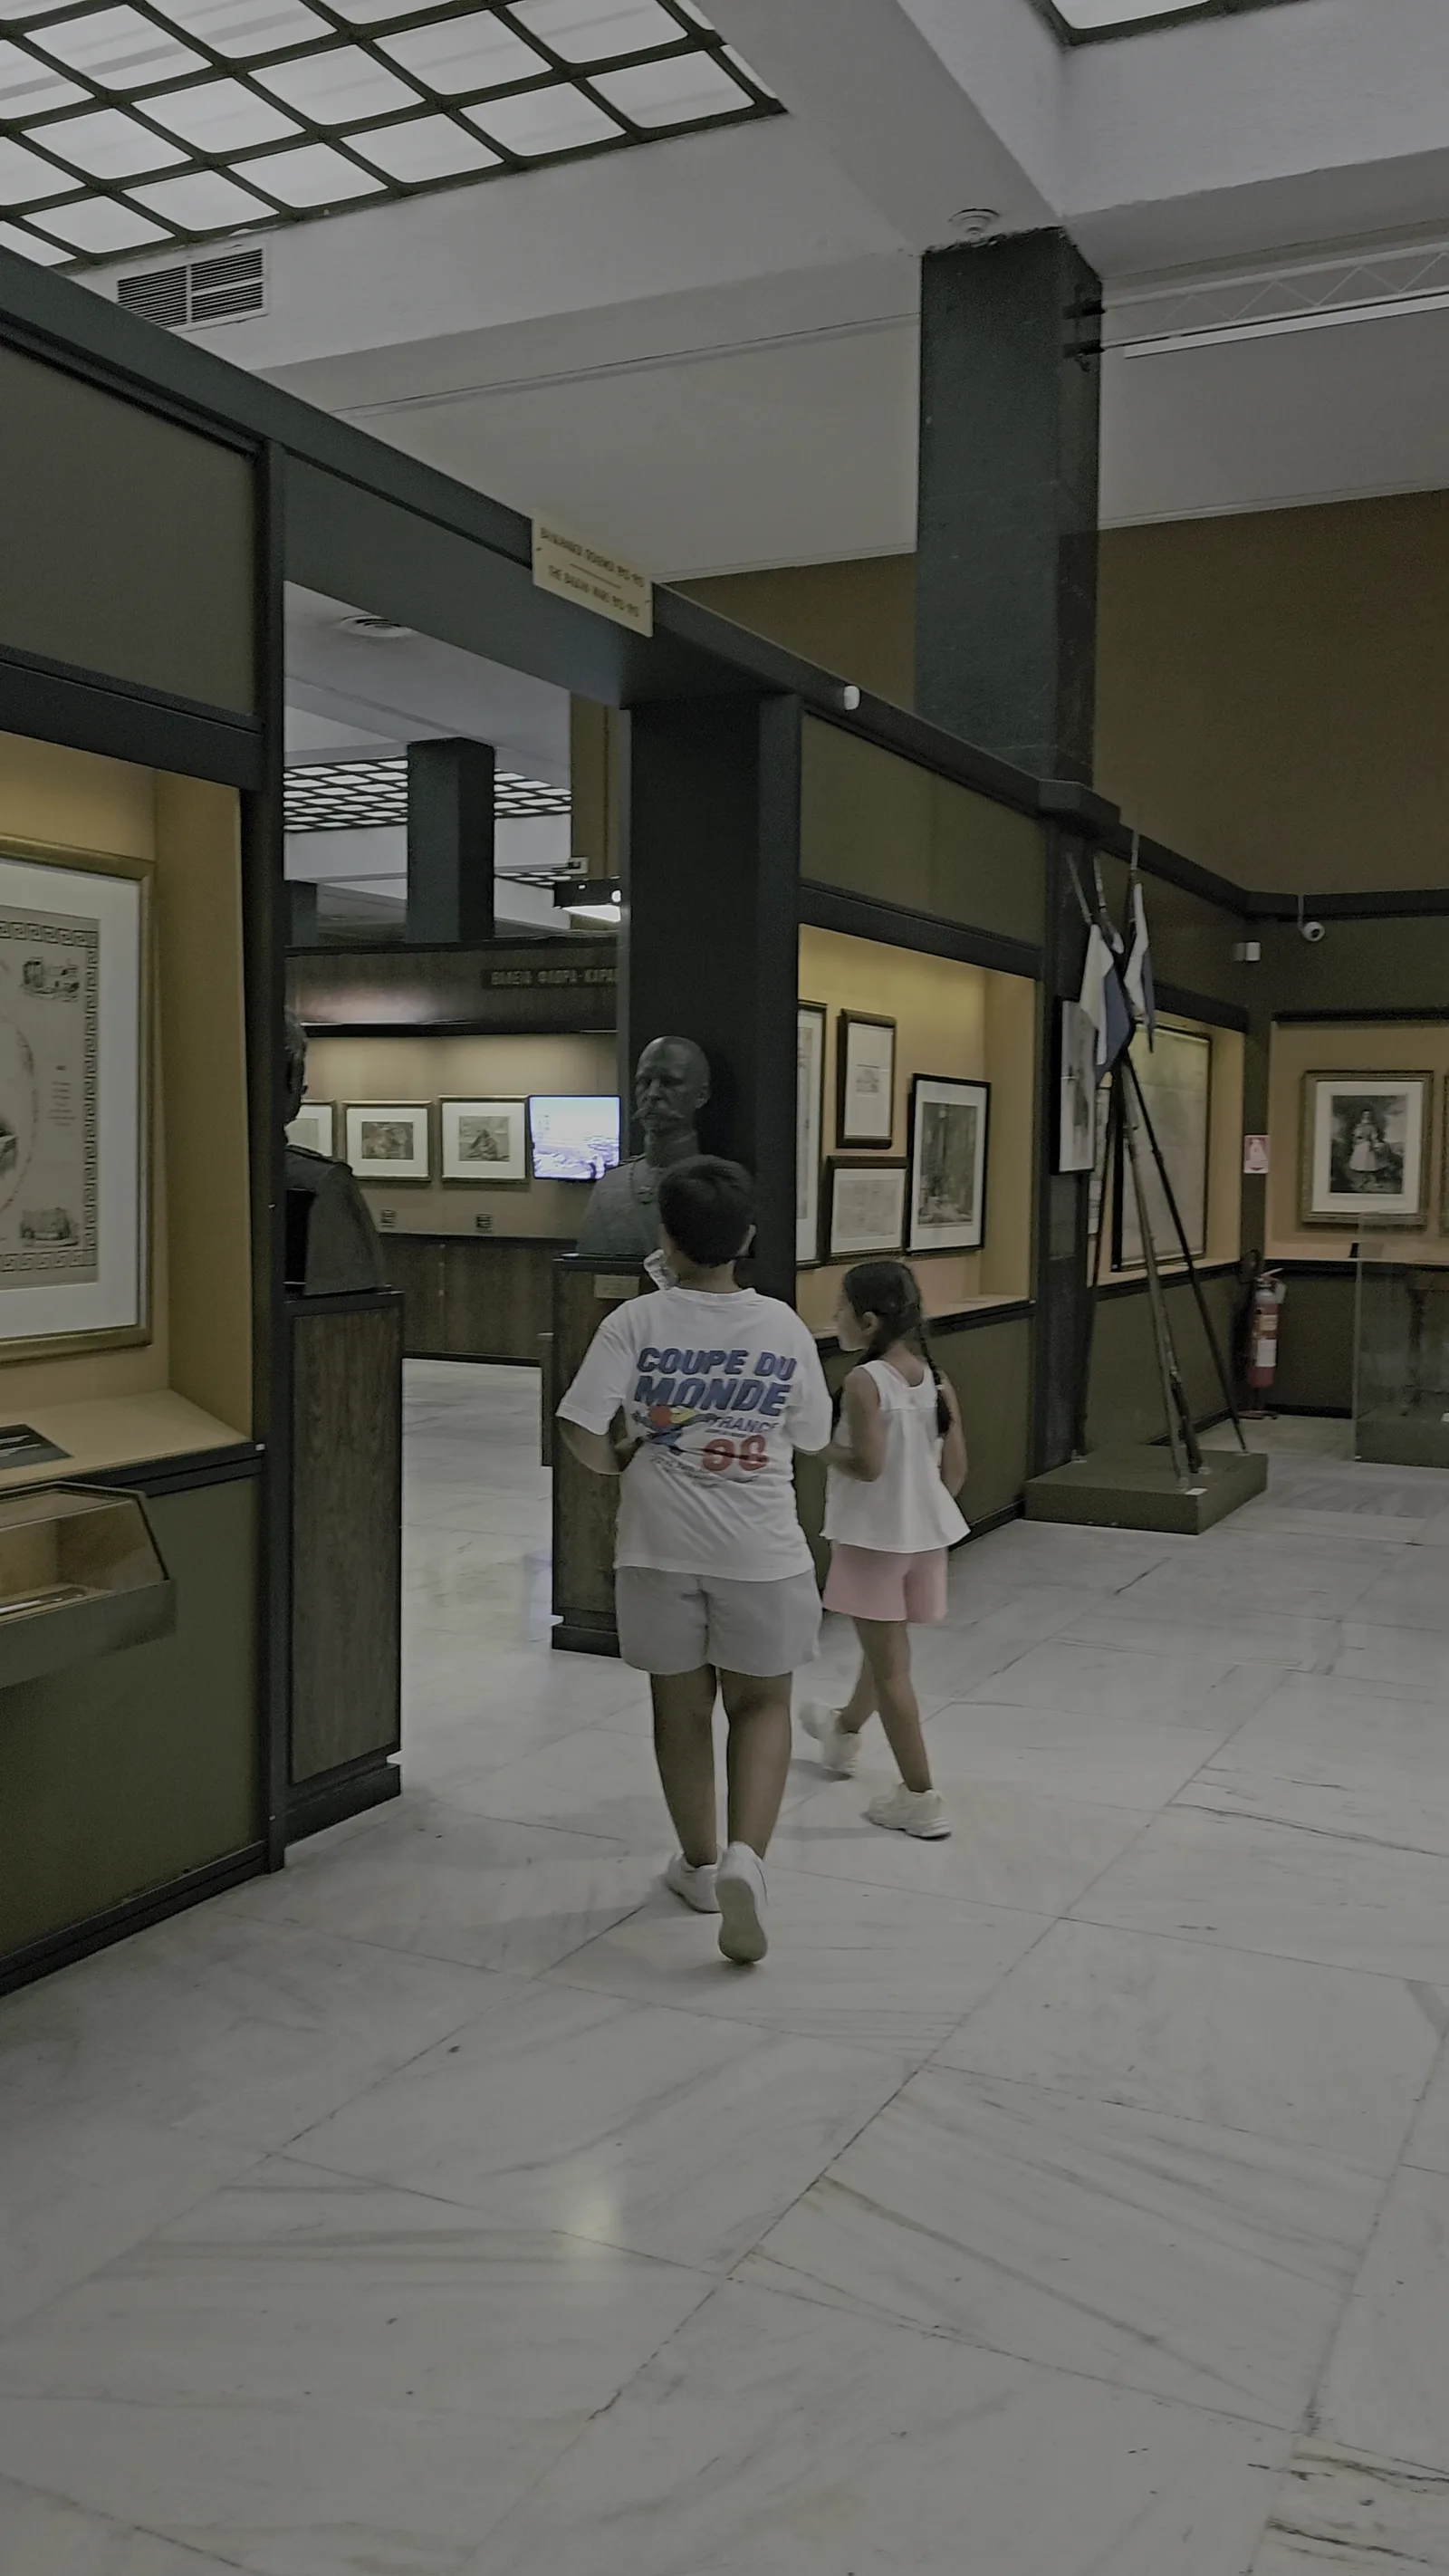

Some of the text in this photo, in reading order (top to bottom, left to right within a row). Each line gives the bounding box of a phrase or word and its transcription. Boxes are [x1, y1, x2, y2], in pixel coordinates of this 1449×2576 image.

[637, 1347, 797, 1381] COUPE DU
[634, 1375, 792, 1417] MONDE
